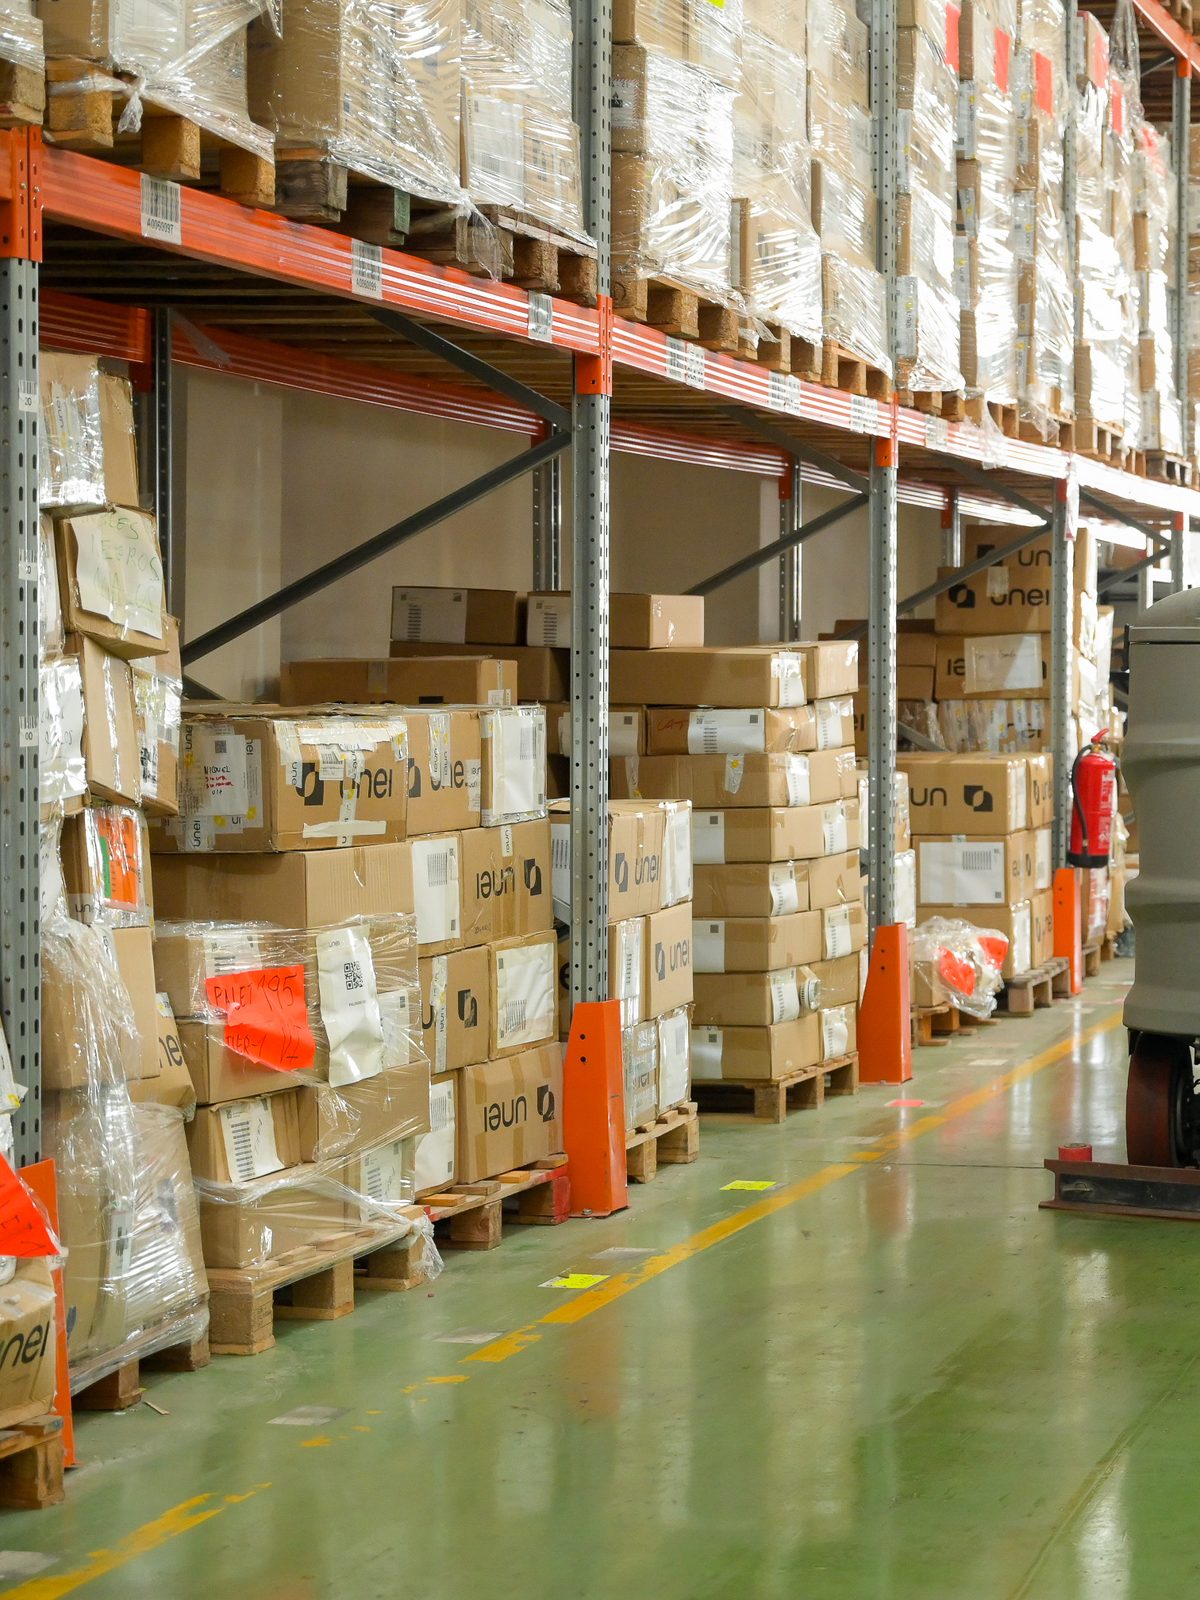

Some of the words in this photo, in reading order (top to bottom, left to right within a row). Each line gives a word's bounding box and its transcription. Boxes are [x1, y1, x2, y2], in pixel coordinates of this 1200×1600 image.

[476, 866, 515, 899] unei
[634, 855, 660, 885] unei
[670, 940, 690, 972] unei
[484, 1096, 526, 1132] unei
[0, 1321, 50, 1369] nei
